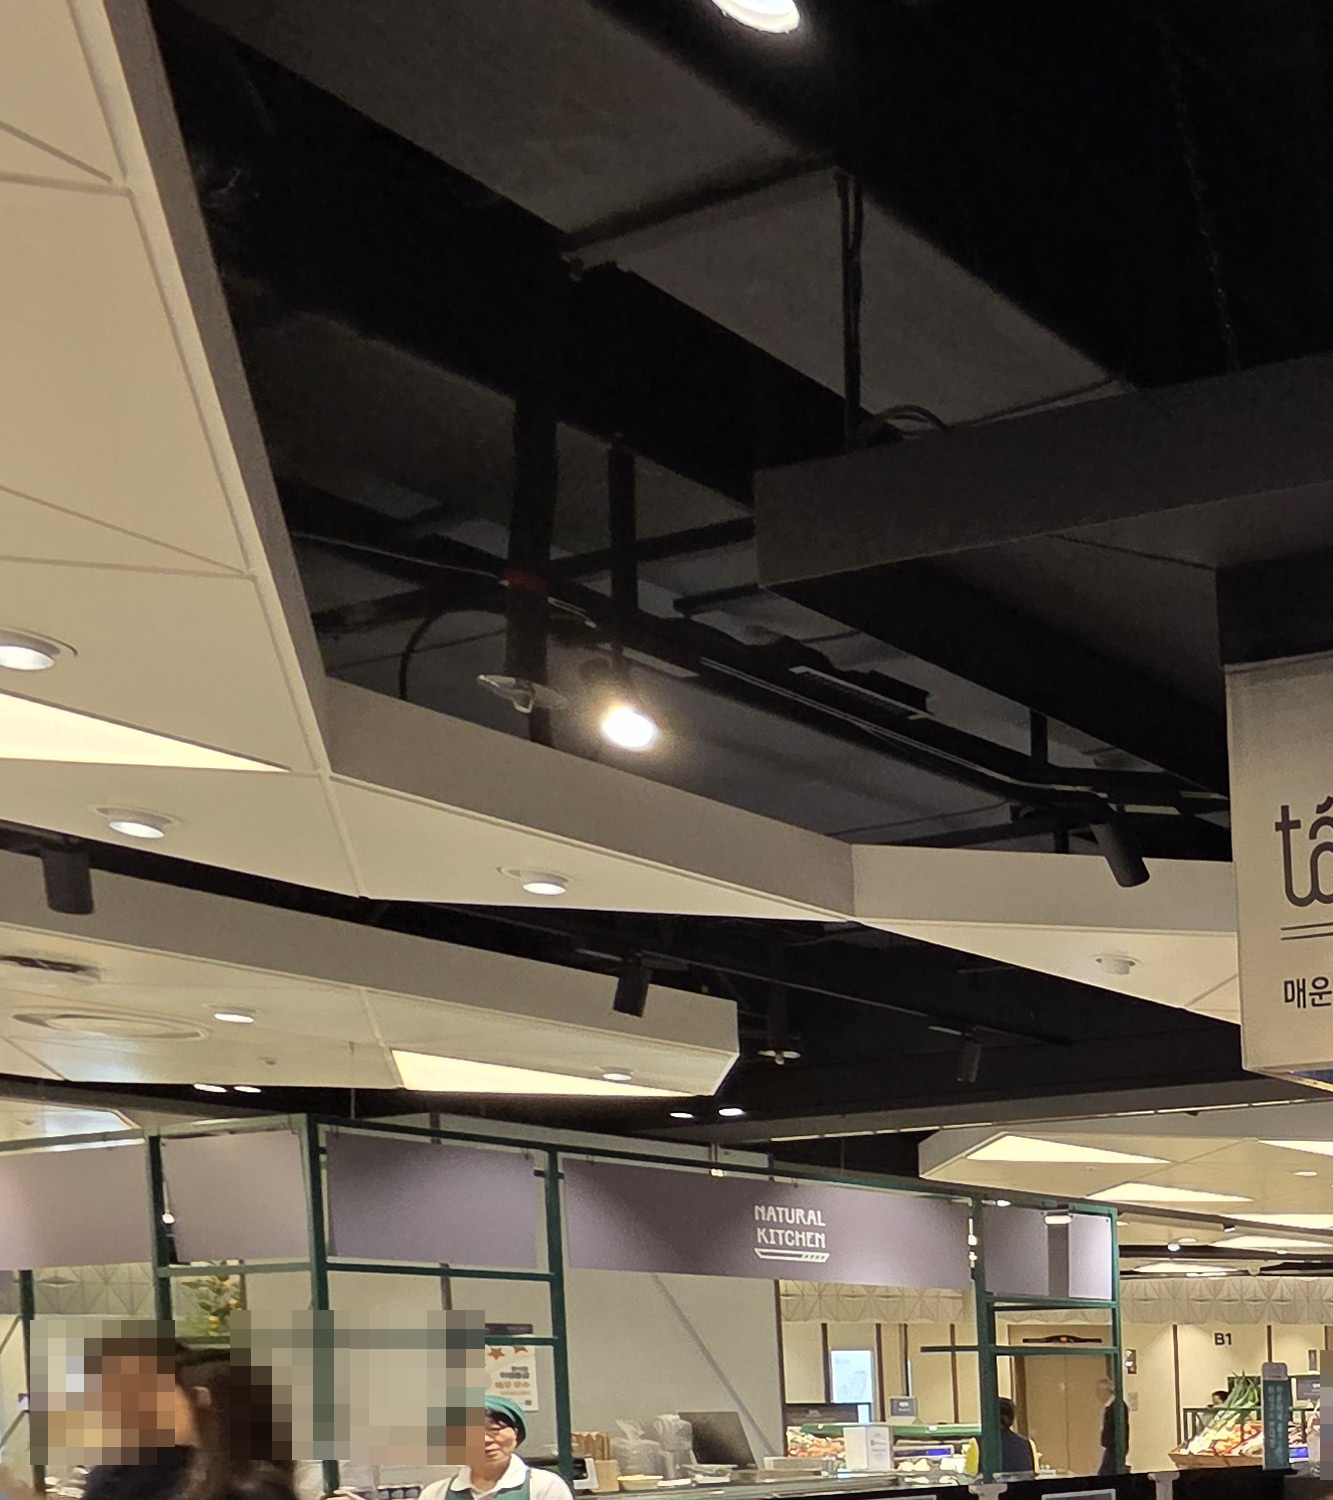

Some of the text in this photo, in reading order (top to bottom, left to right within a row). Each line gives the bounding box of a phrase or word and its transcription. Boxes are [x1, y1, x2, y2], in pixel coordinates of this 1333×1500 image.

[1284, 978, 1332, 1008] 매운
[755, 1205, 826, 1226] NATURAL
[757, 1227, 826, 1248] KITCHEN
[1214, 1333, 1232, 1346] B1
